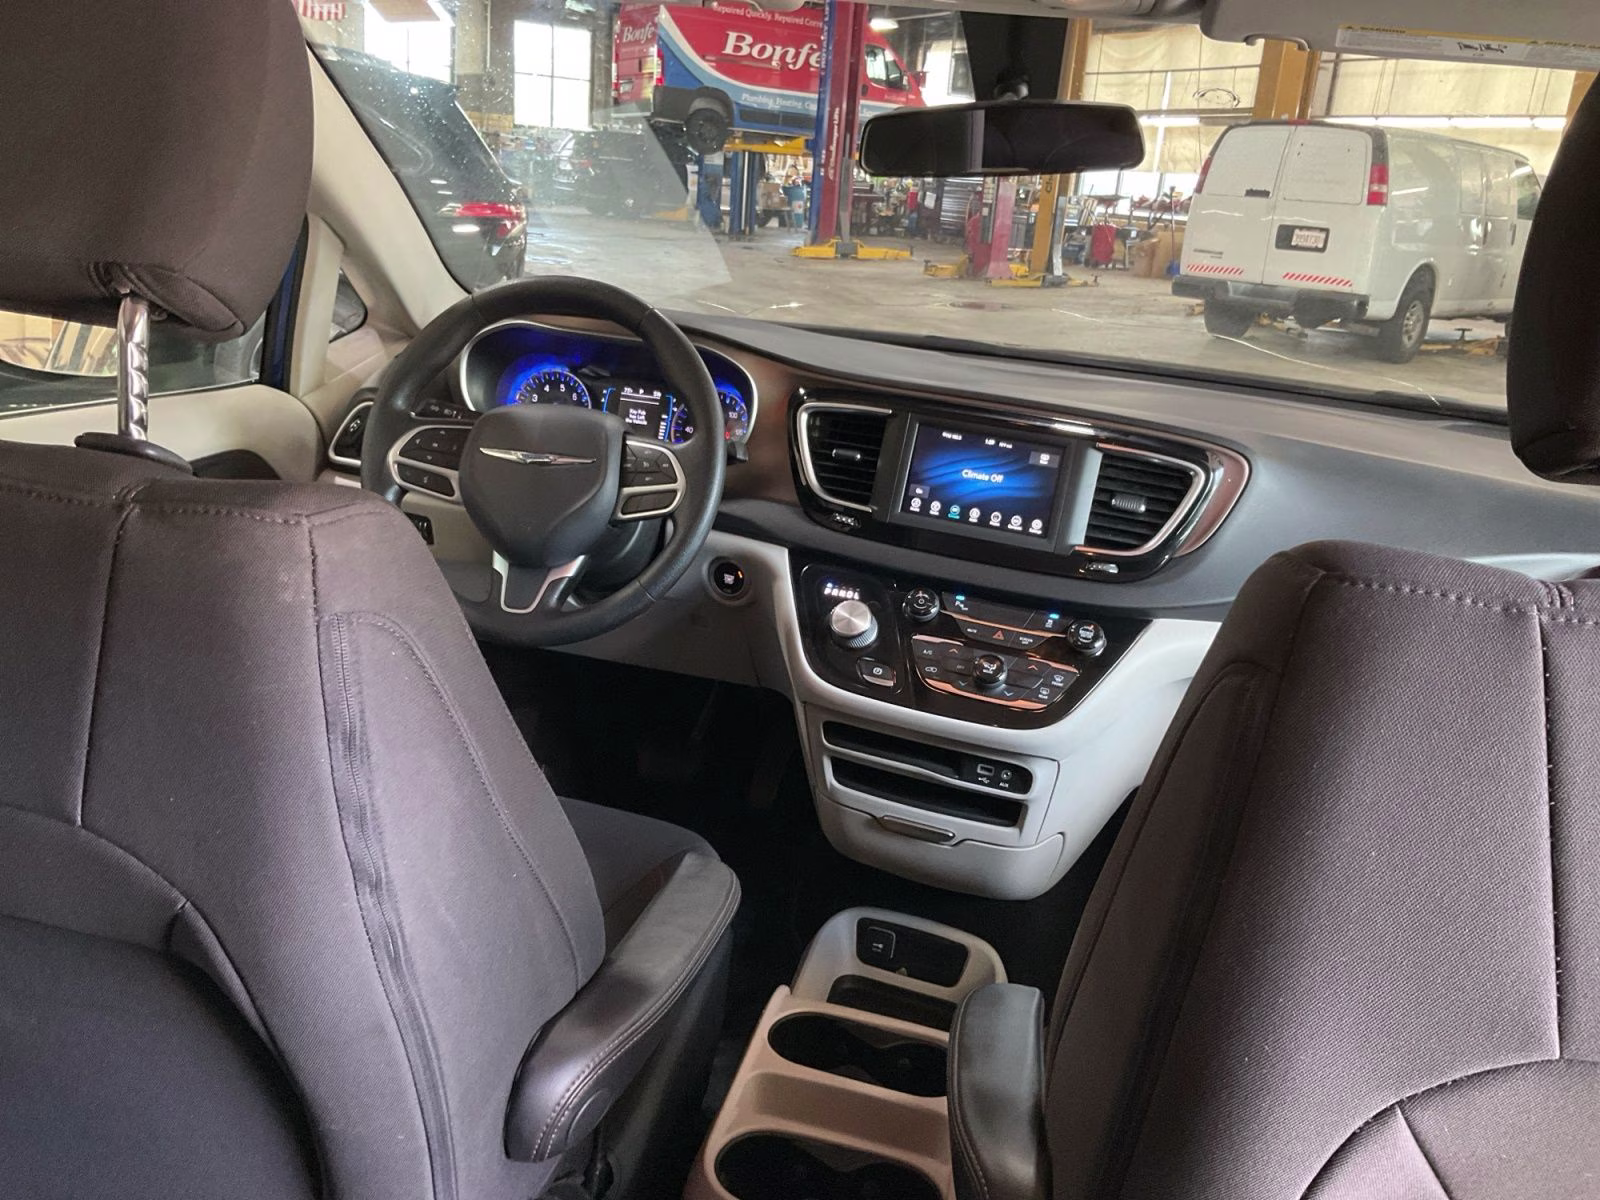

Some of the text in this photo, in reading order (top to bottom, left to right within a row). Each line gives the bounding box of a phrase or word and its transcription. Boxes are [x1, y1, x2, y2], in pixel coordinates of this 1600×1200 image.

[543, 383, 566, 393] 4 5
[531, 393, 539, 403] 3
[571, 392, 578, 401] 6
[961, 468, 1004, 483] Climate Off
